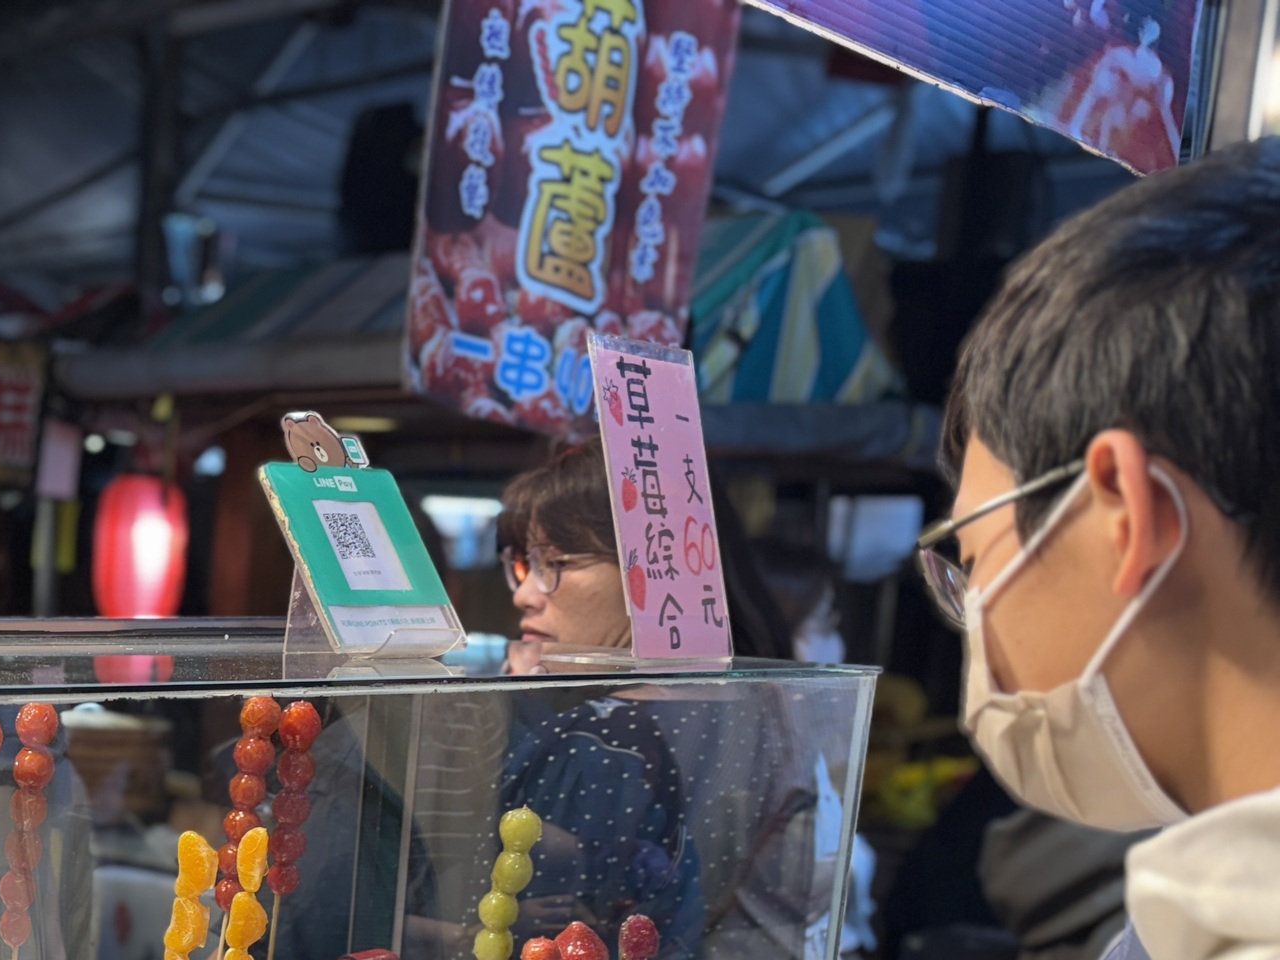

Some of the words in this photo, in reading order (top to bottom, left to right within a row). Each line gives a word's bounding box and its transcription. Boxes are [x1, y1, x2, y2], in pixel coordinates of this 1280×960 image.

[313, 477, 336, 488] LINE
[616, 356, 684, 649] 草莓綜合
